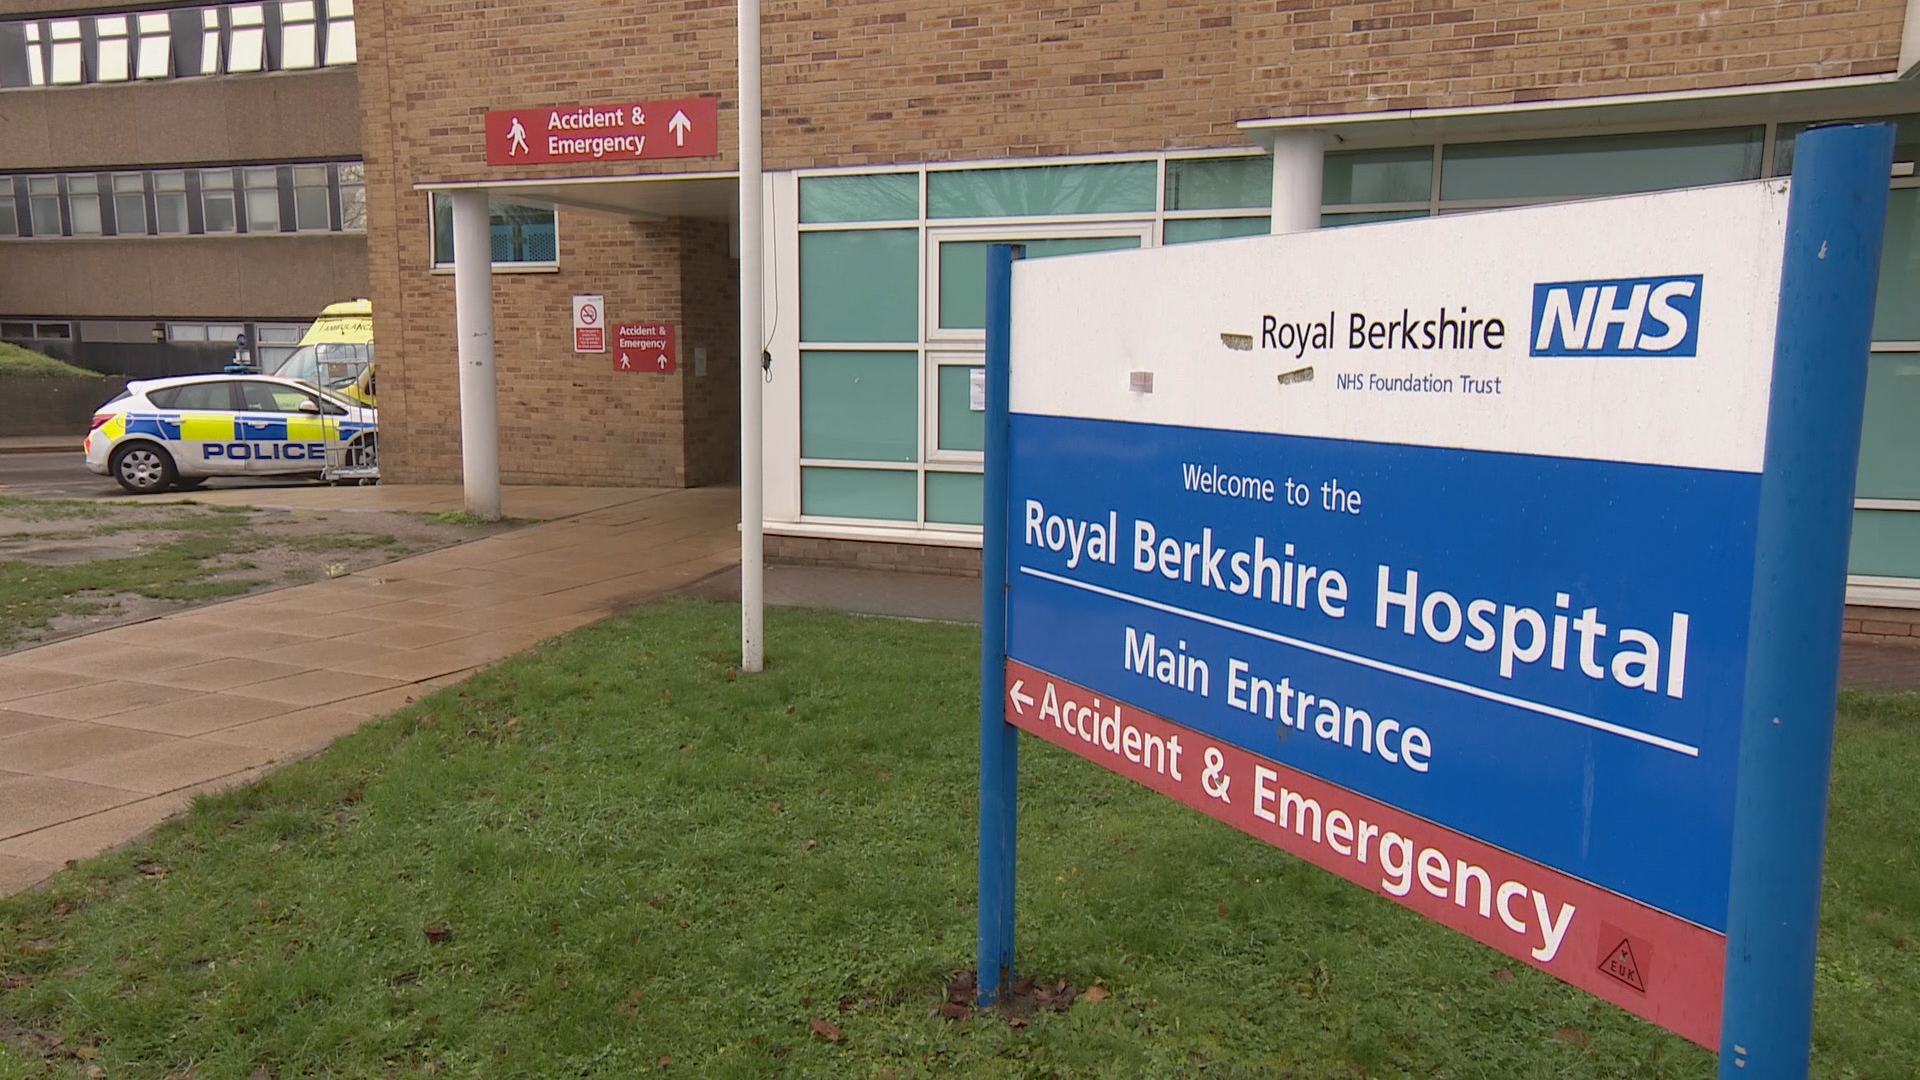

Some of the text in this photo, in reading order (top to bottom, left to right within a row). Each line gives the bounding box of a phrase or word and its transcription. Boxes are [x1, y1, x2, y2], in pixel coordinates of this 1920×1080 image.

[548, 106, 645, 130] Accident &
[548, 135, 645, 157] Emergency
[1535, 280, 1696, 352] NHS
[619, 325, 666, 336] Accident &
[1262, 306, 1505, 359] Royal Berkshire
[619, 338, 666, 351] Emergency
[1336, 373, 1502, 395] NHS Foundation Trust
[202, 443, 325, 460] POLICE
[1182, 462, 1362, 515] Welcome to the
[1025, 498, 1689, 699] Royal Berkshire Hospital
[1124, 626, 1432, 773] Main Entrance
[1038, 682, 1576, 962] Accident & Emergency
[1610, 960, 1635, 981] EUK
